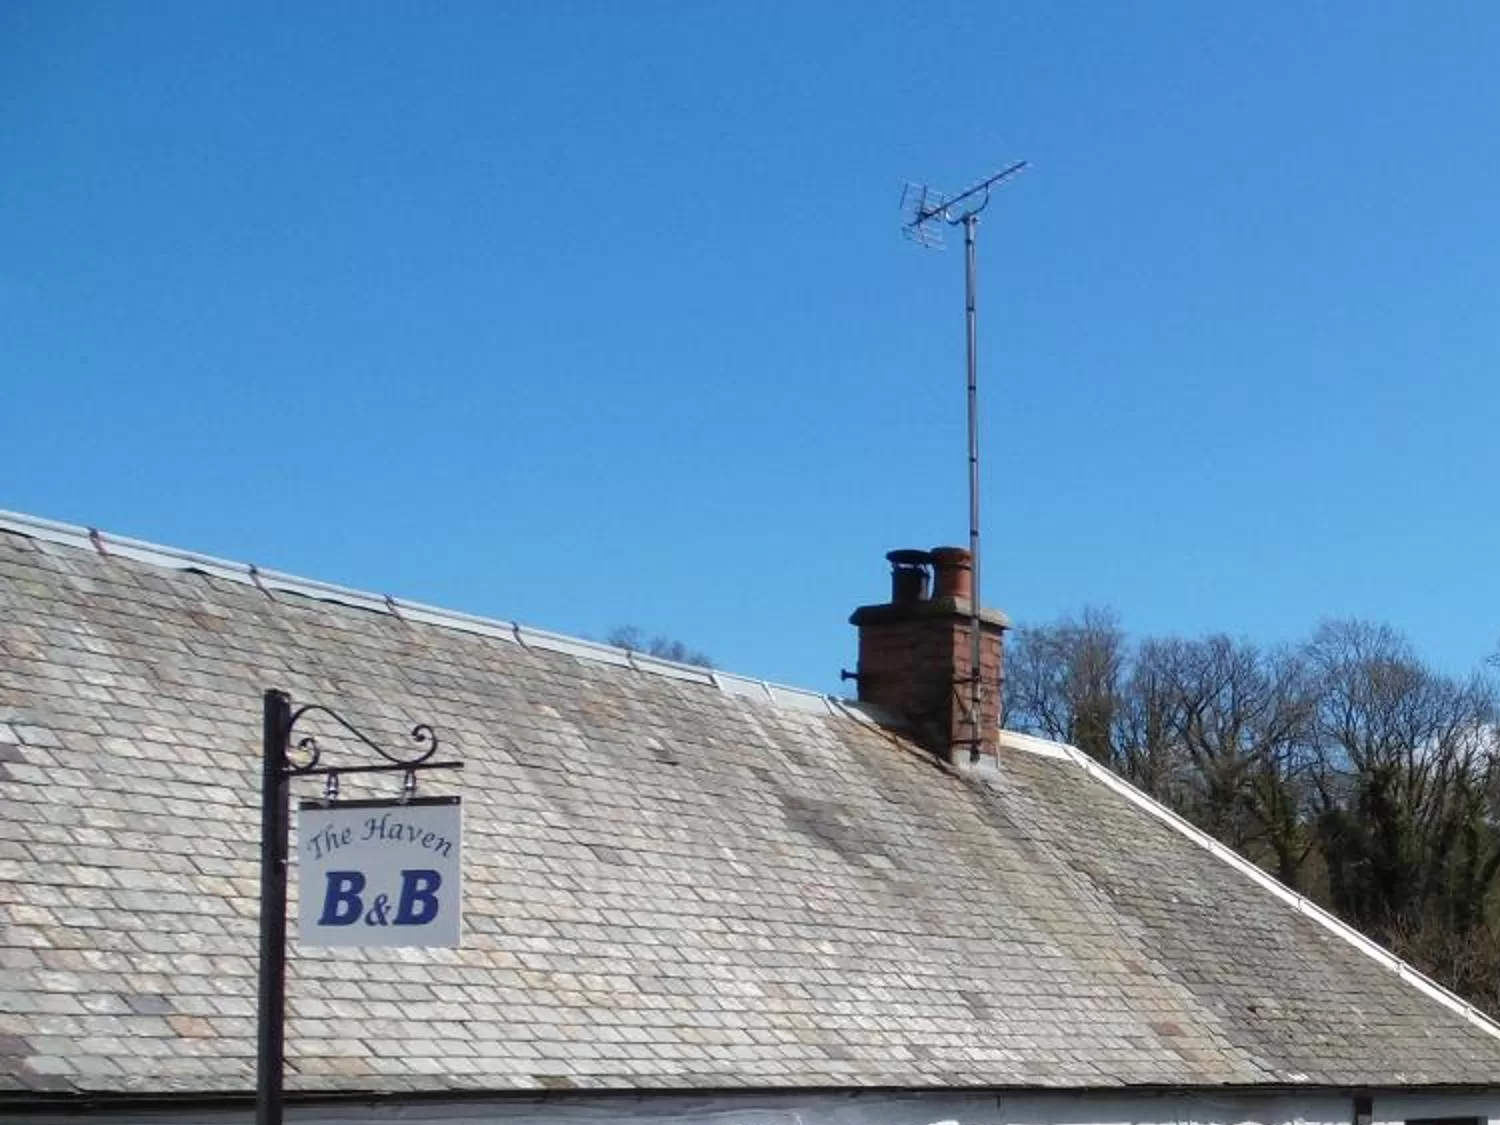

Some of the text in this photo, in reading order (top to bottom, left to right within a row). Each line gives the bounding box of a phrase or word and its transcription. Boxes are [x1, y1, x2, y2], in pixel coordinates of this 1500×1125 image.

[307, 812, 453, 860] The Haven
[317, 869, 442, 926] B&B
